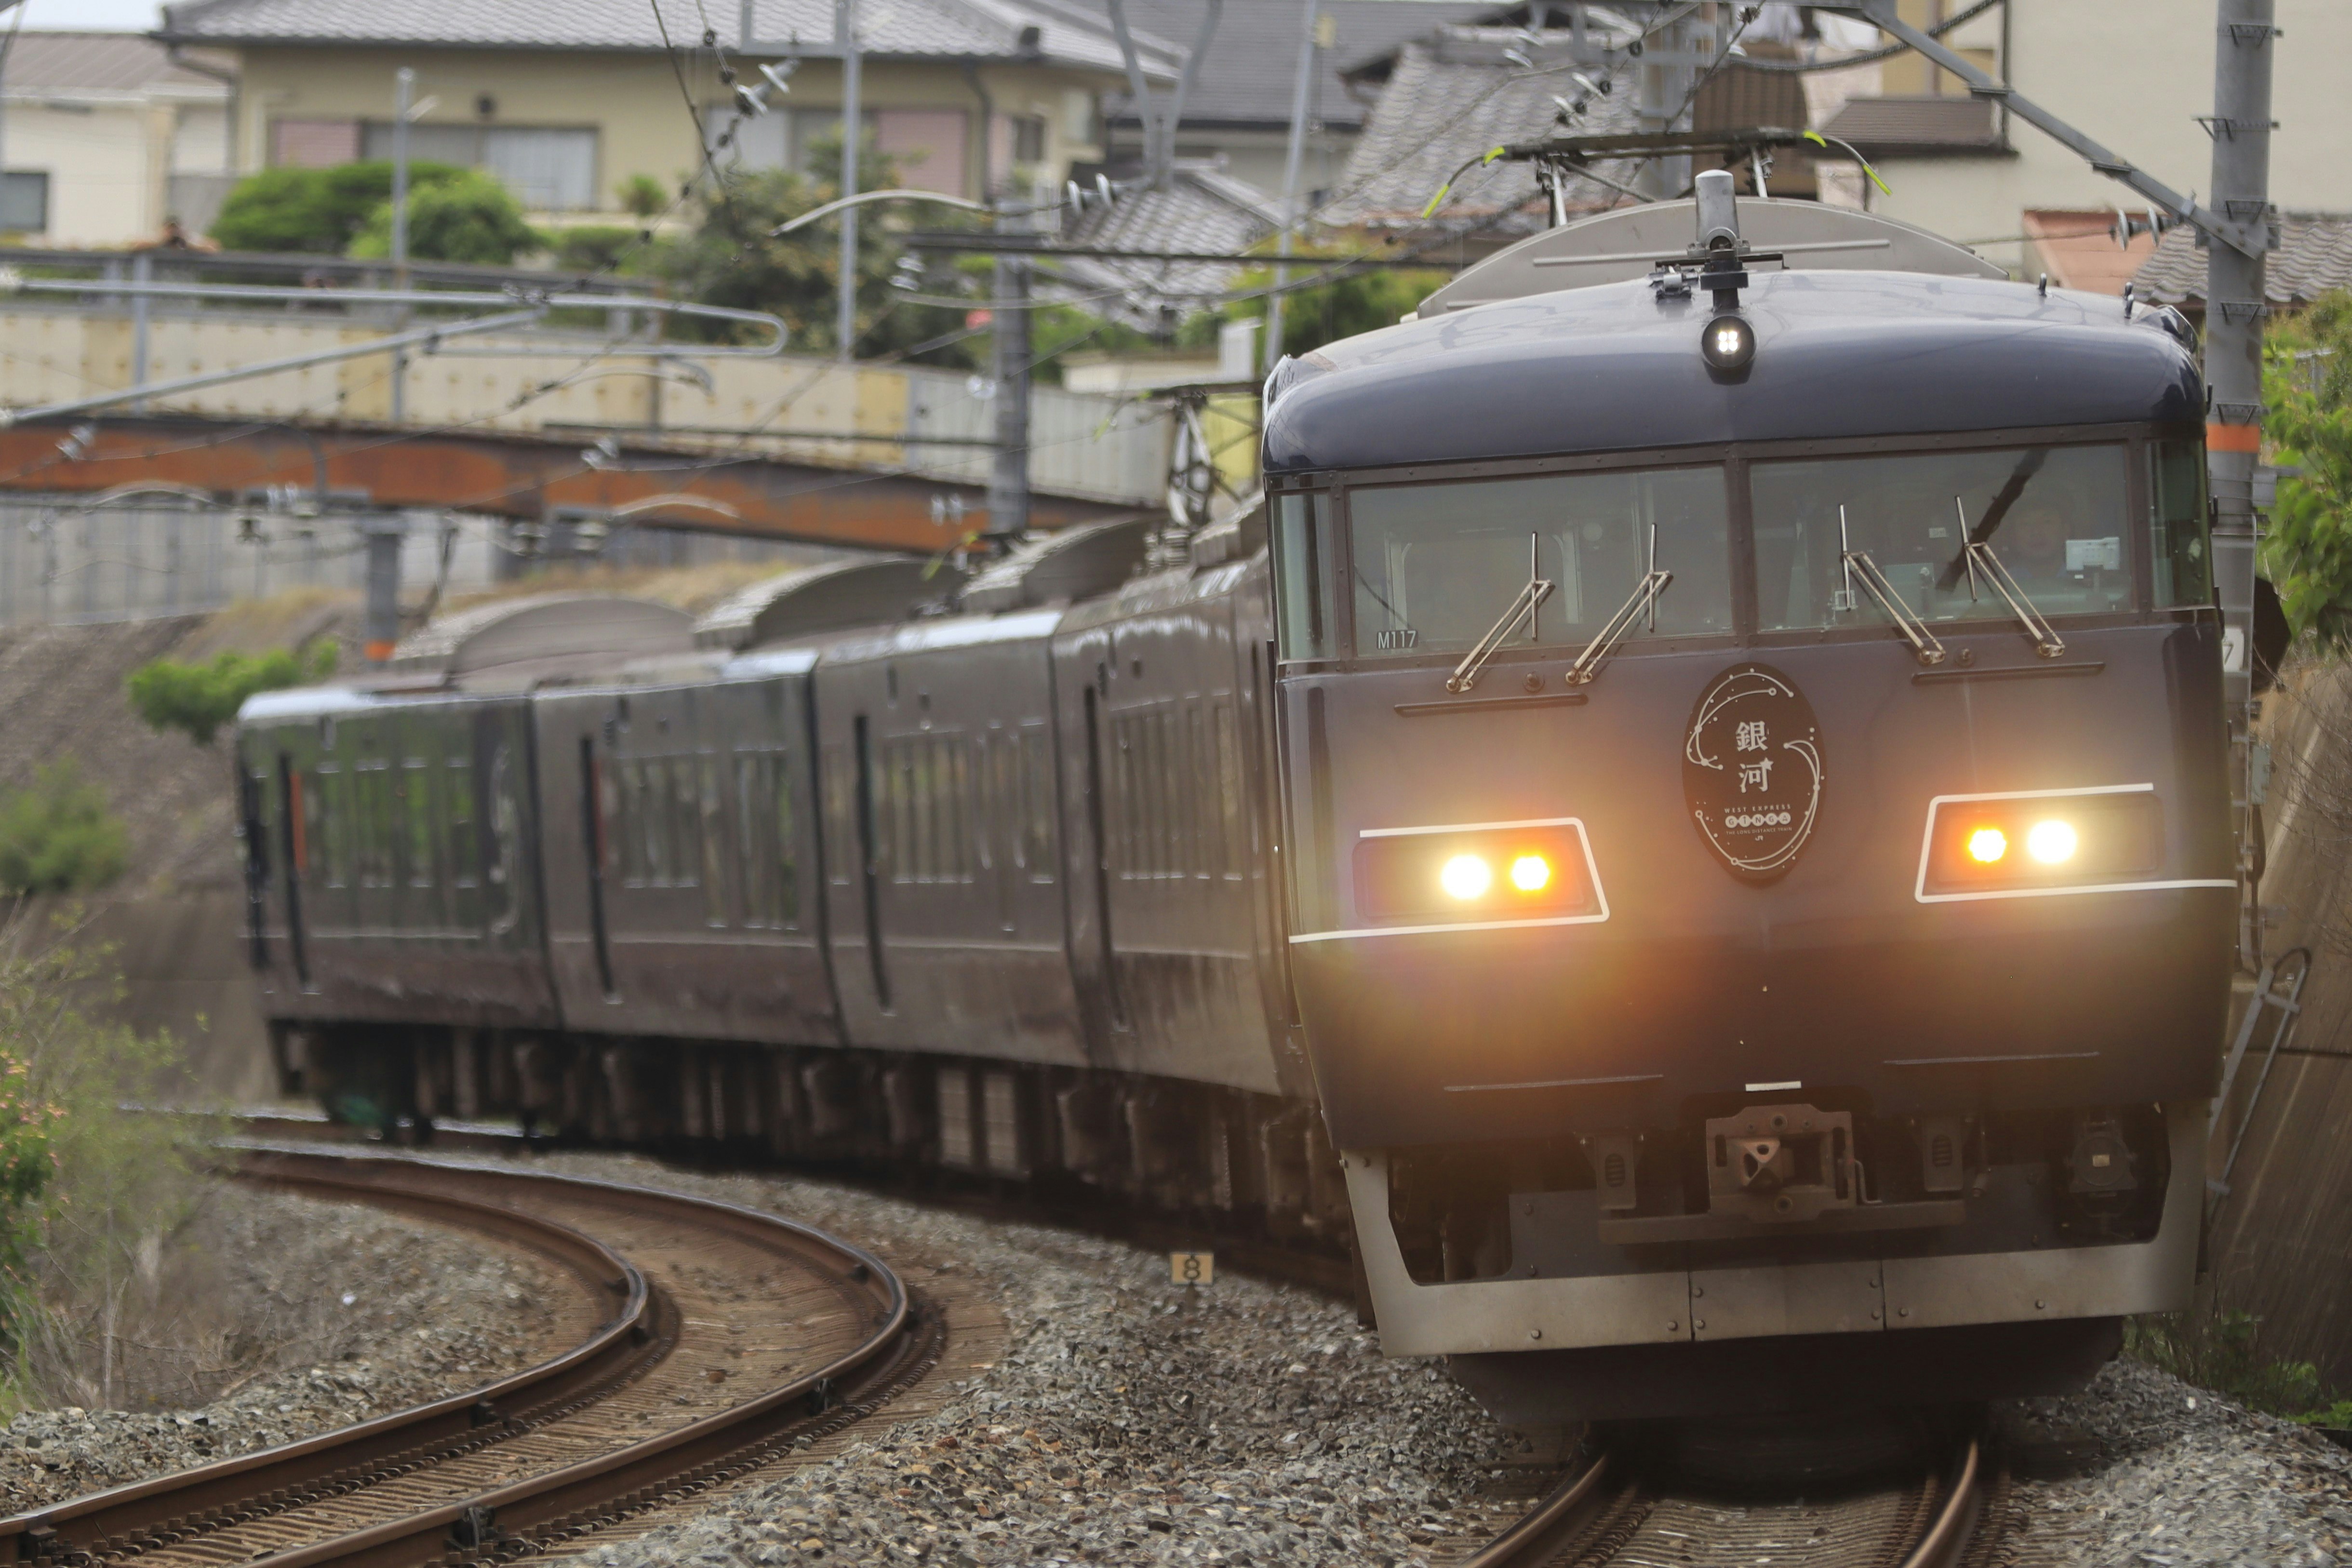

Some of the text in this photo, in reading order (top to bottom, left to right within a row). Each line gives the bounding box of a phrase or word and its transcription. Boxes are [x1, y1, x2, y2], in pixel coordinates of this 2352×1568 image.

[1378, 630, 1417, 649] M117
[1736, 721, 1774, 793] 銀河
[1184, 1259, 1201, 1280] 8
